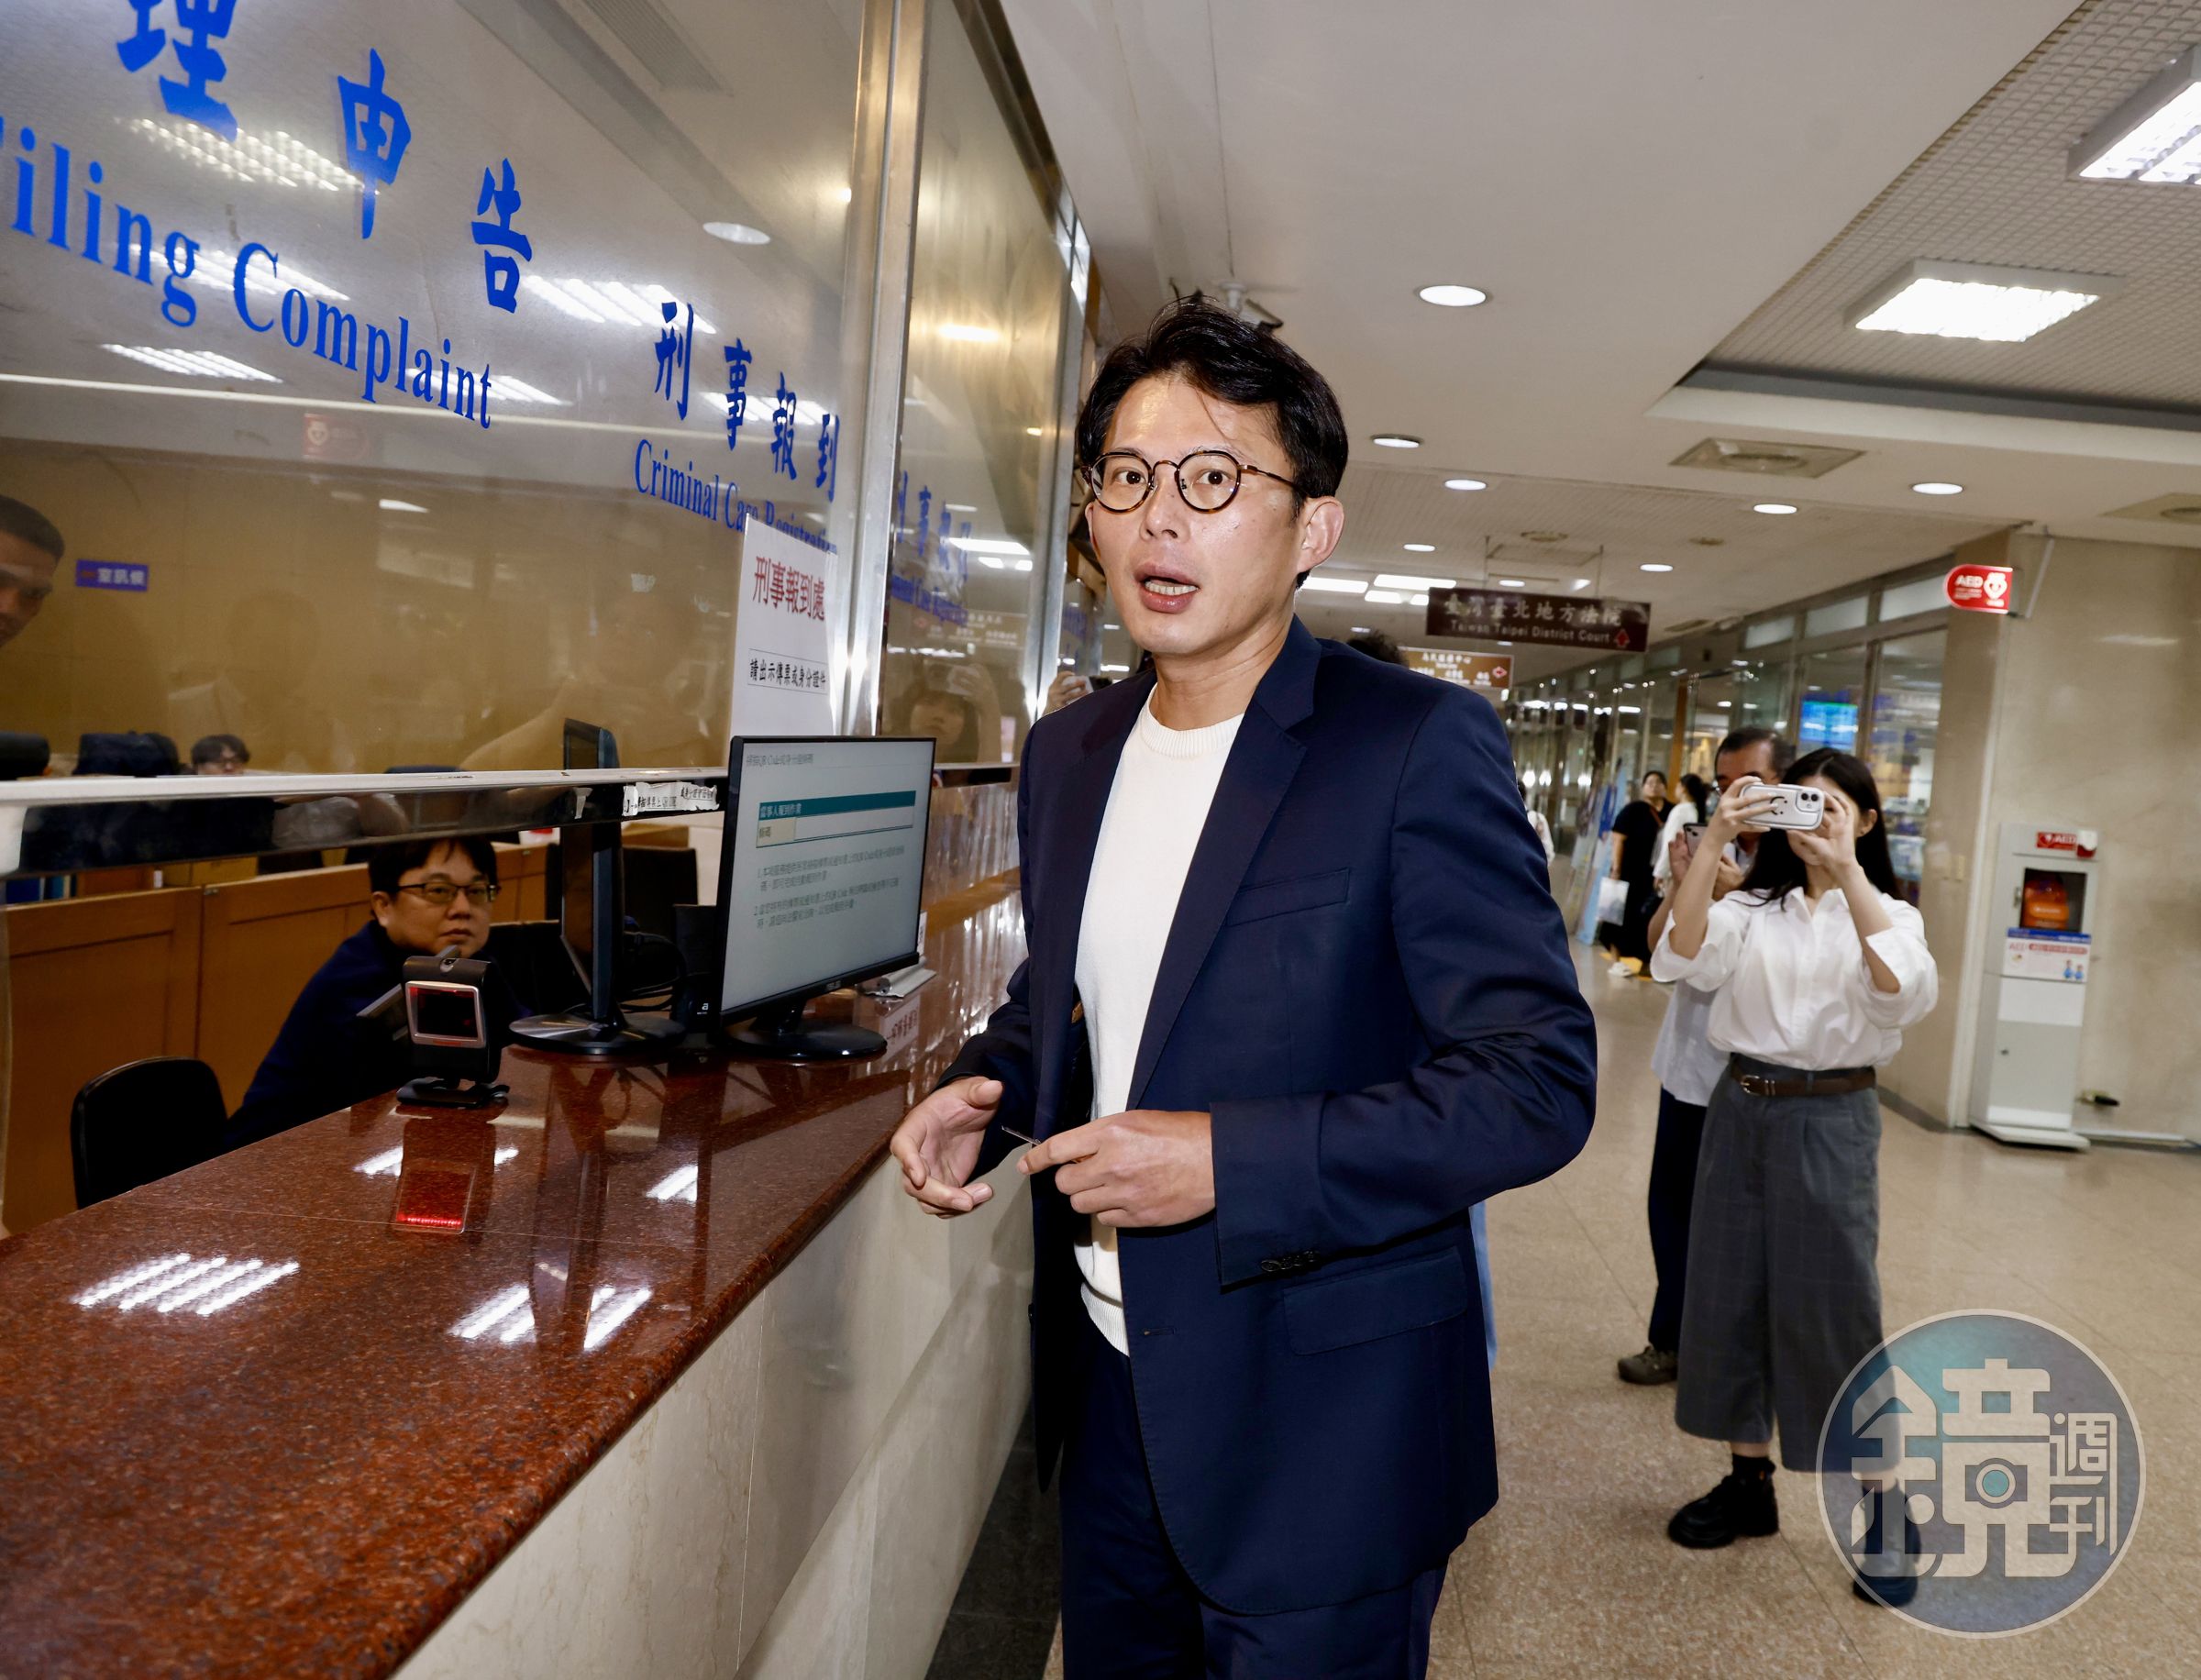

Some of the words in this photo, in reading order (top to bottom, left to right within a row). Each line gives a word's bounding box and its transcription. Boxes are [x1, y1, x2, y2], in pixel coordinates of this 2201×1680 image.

[0, 116, 200, 327] iling
[233, 242, 492, 429] Complaint
[654, 301, 840, 503] 刑事報到
[635, 439, 720, 522] Criminal
[752, 555, 825, 622] 刑事報到處
[1954, 574, 1984, 589] AED
[1494, 623, 1529, 638] Taipei
[1532, 625, 1575, 641] District
[1578, 630, 1609, 642] Court
